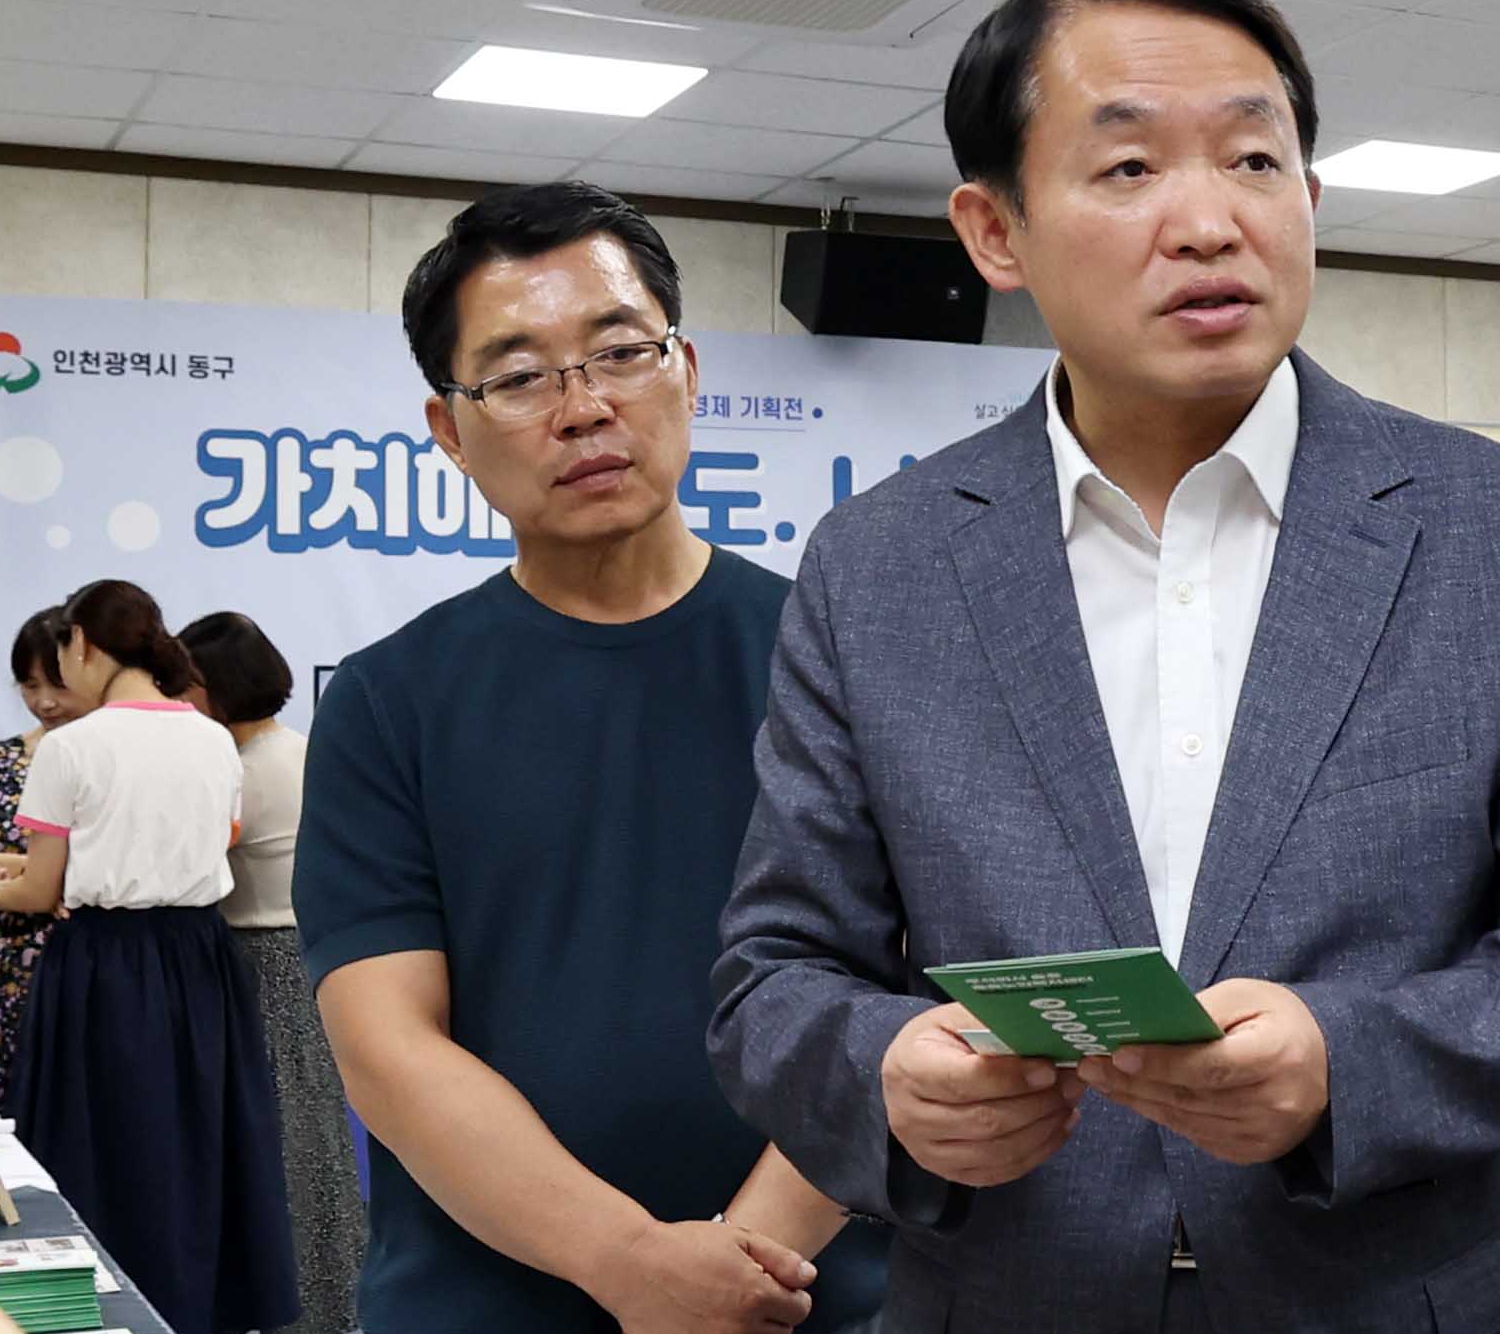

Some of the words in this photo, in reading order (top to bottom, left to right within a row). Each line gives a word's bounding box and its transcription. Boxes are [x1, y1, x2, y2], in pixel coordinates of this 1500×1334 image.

[52, 349, 177, 377] 인천광역시
[187, 354, 235, 380] 동구
[740, 395, 803, 420] 기획전
